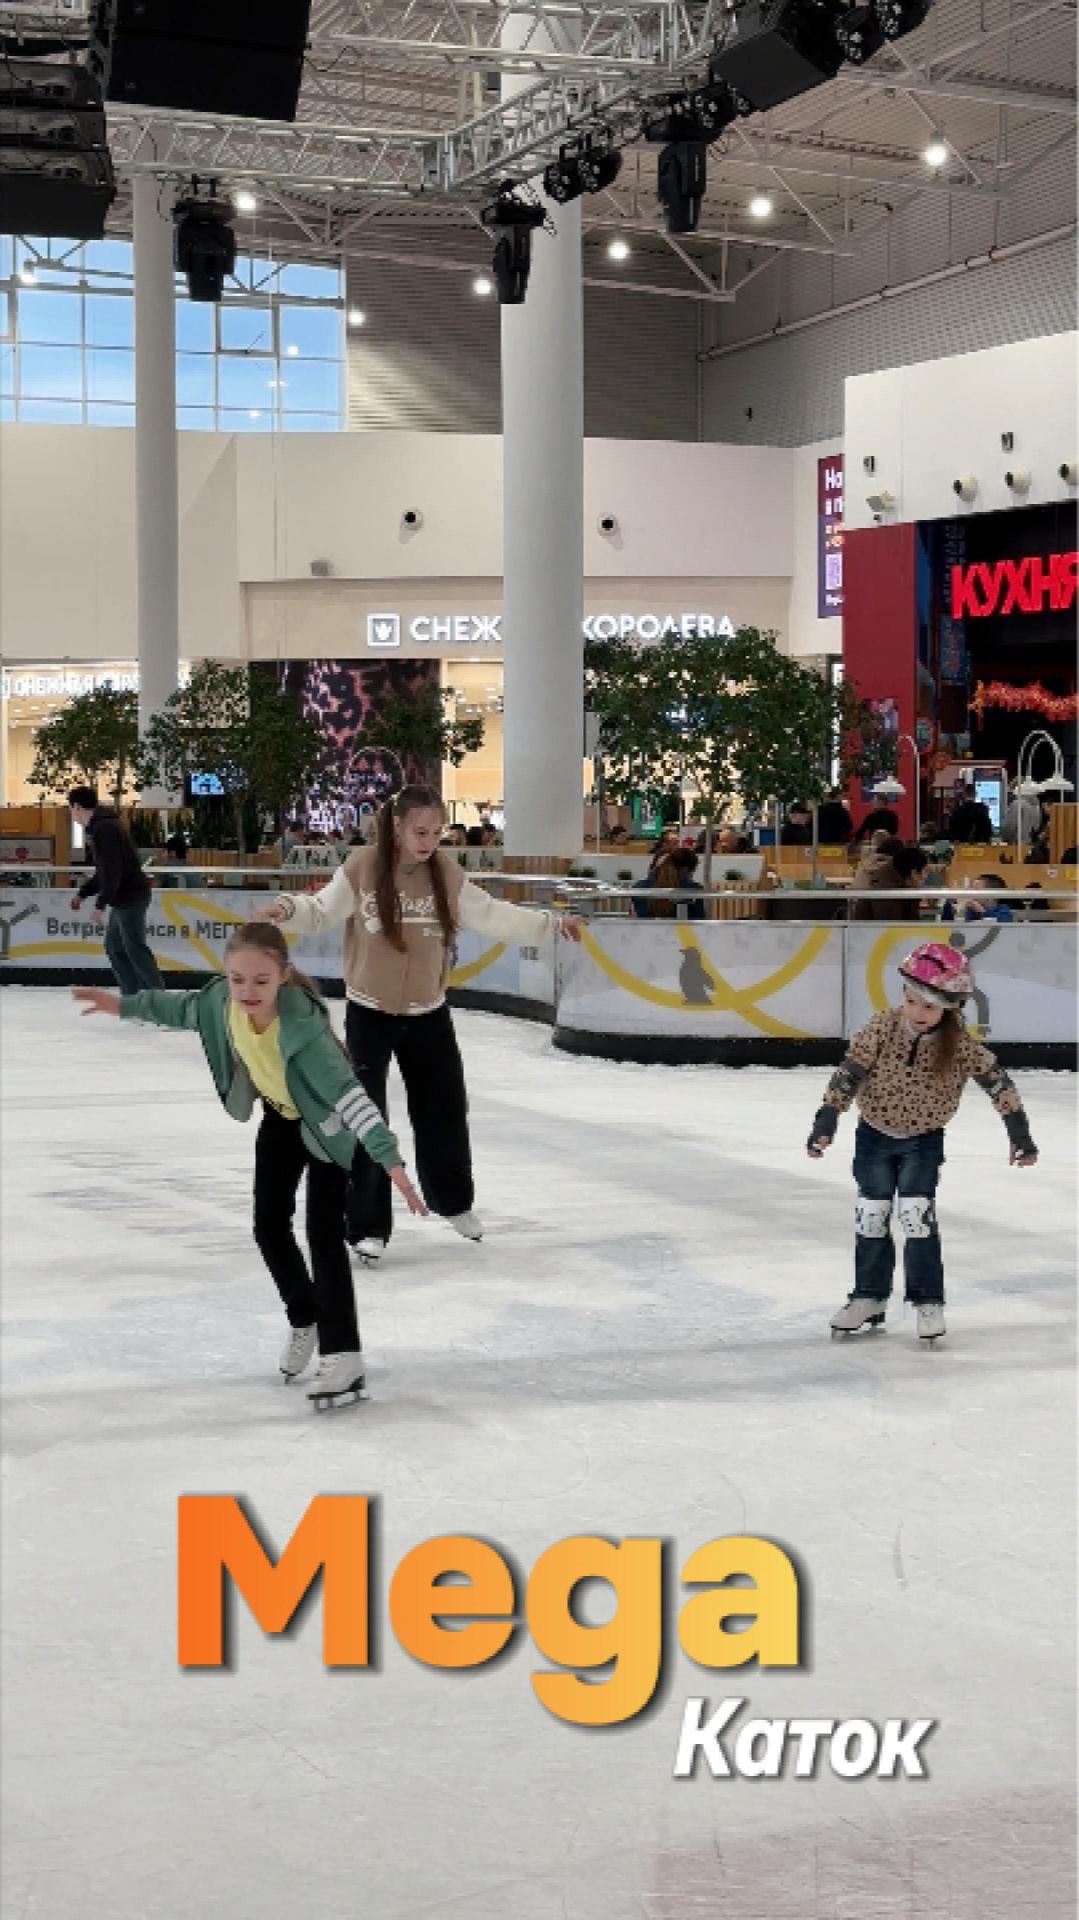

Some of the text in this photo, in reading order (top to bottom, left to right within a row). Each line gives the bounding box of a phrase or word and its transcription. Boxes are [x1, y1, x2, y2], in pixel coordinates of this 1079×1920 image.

[951, 552, 1078, 619] КУХНЯ
[409, 614, 736, 642] СНЕЖ КОРОЛЕВА
[47, 916, 177, 939] Встремся
[196, 918, 243, 939] МЕГ
